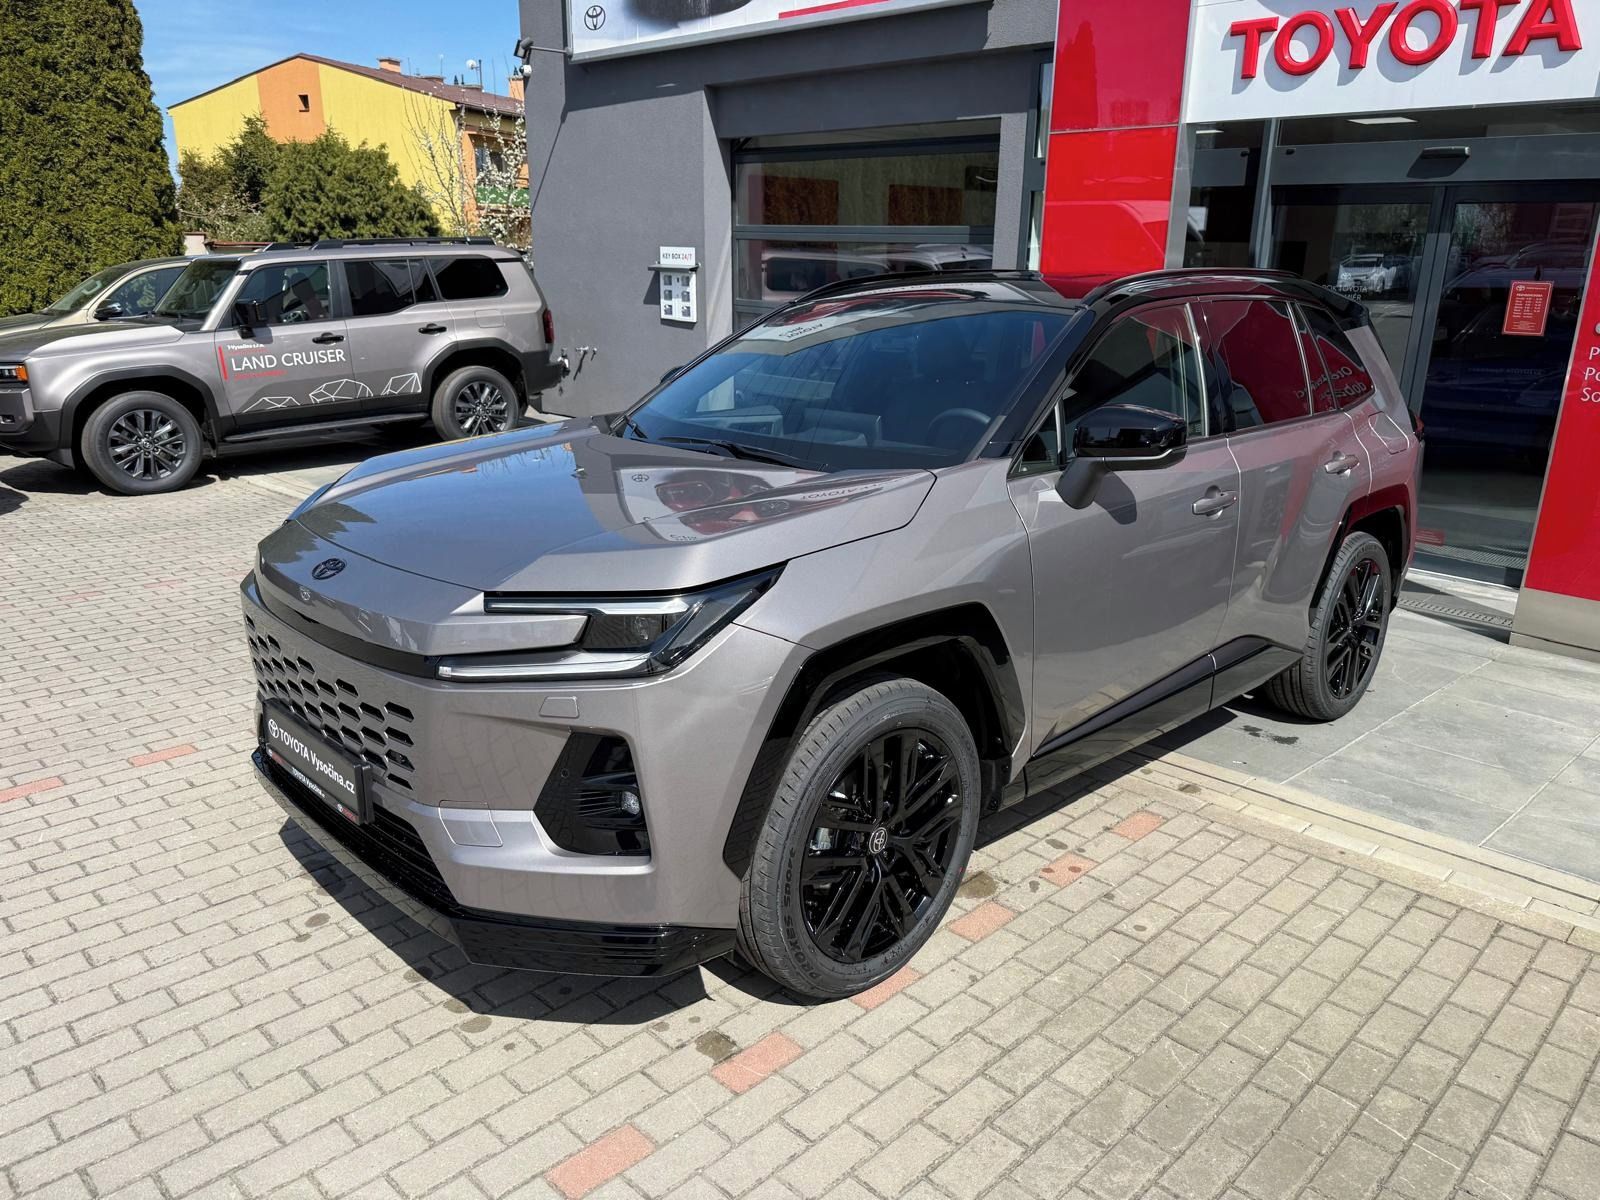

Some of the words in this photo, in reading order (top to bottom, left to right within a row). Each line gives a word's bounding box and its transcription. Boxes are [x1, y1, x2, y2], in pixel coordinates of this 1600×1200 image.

[1230, 0, 1582, 79] TOYOTA
[231, 354, 277, 372] LAND
[281, 348, 346, 367] CRUISER
[279, 727, 310, 762] TOYOTA
[310, 749, 355, 794] Vysočina.cz
